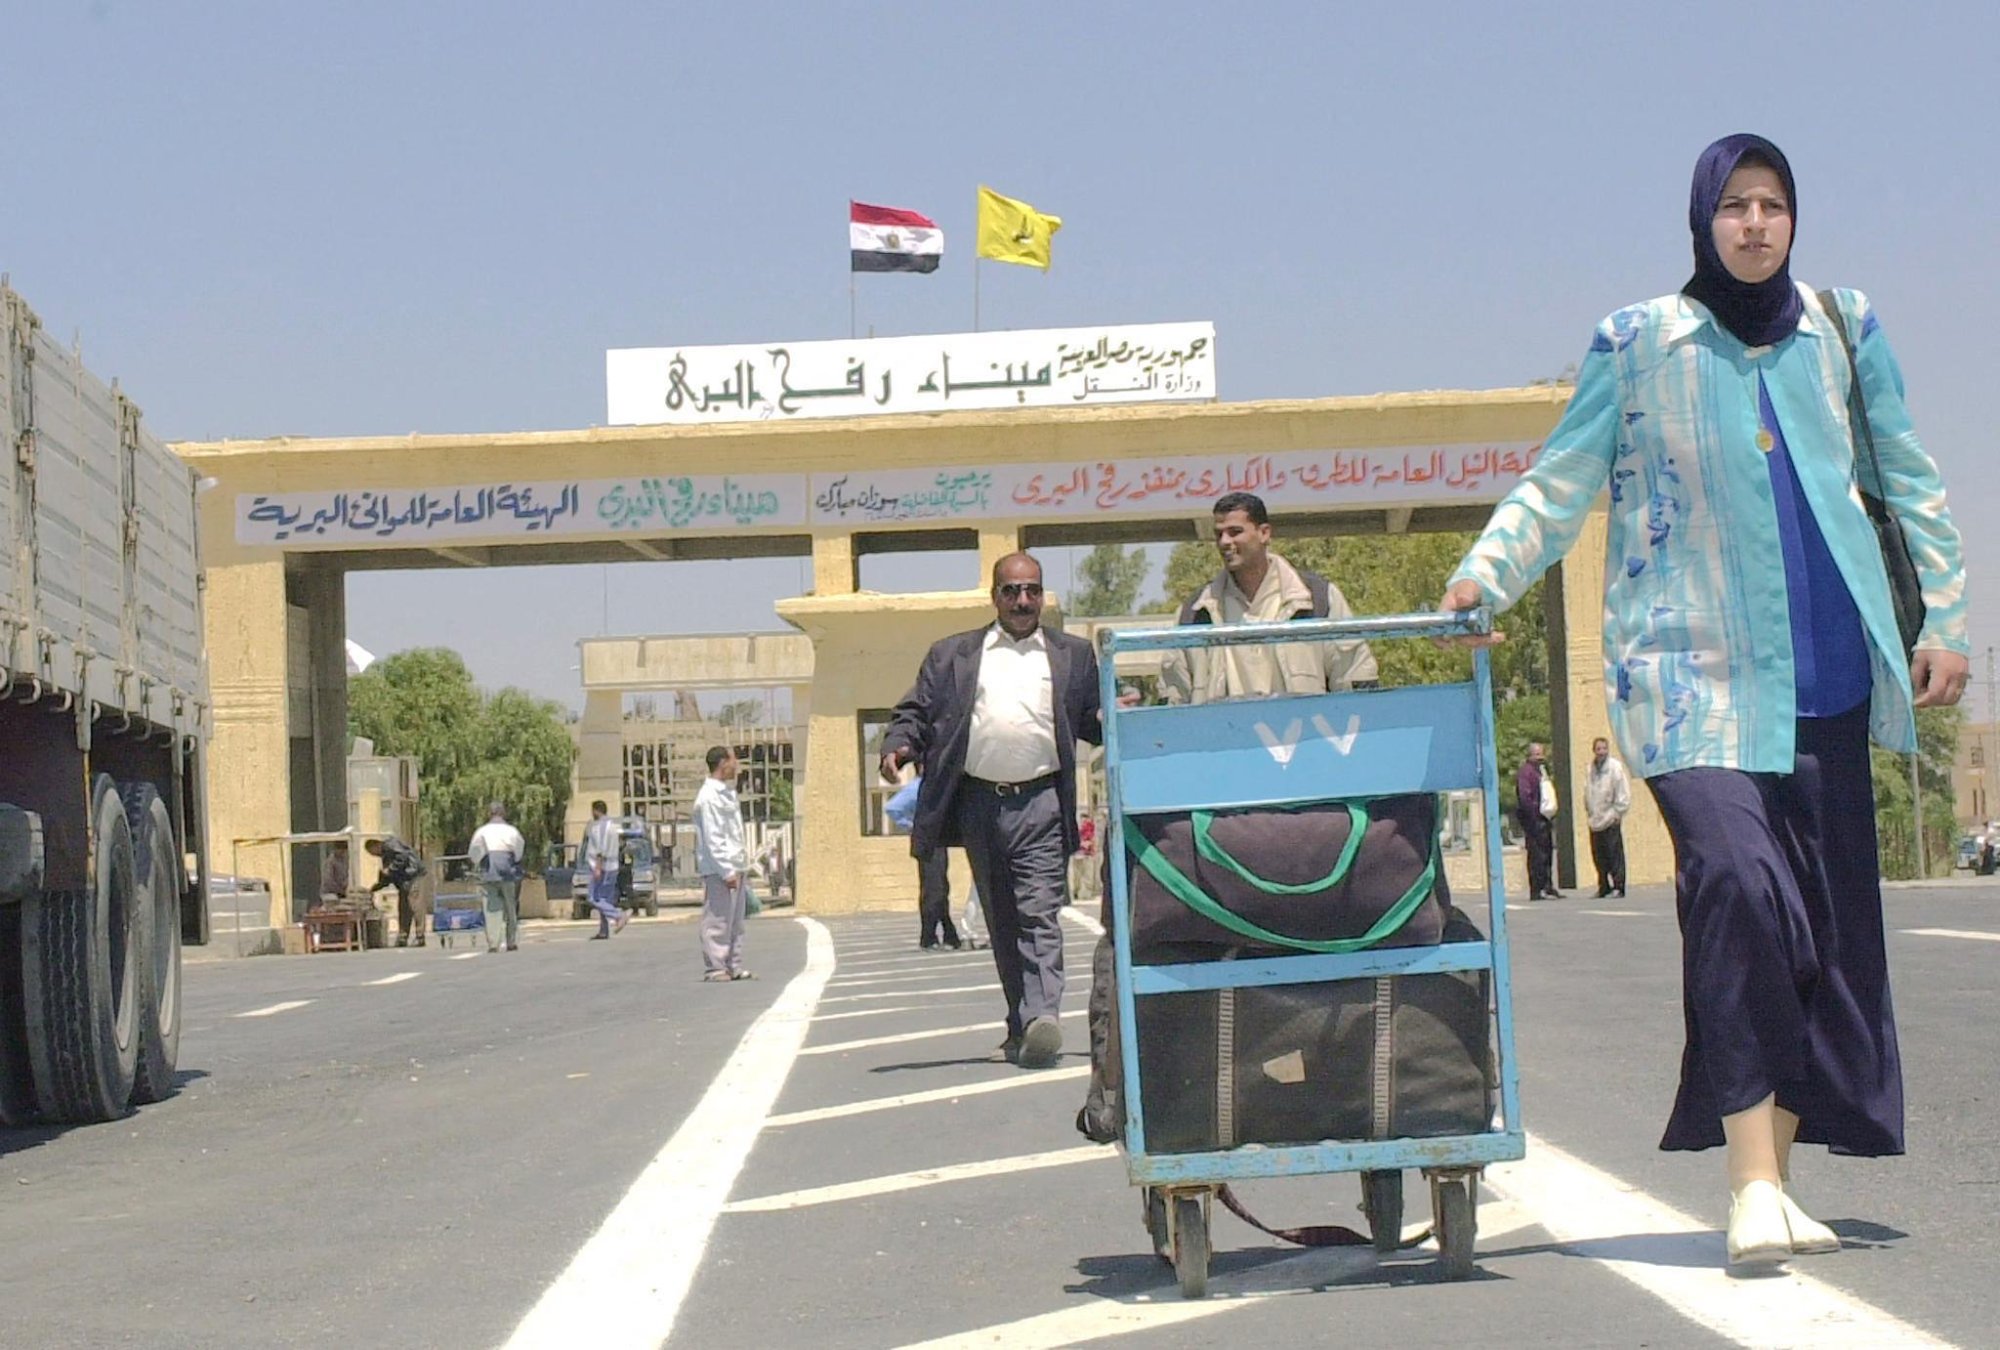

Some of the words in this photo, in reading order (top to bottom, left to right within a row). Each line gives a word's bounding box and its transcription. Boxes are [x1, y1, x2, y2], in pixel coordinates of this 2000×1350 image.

[917, 350, 1052, 403] ميناء
[1135, 337, 1208, 373] جمهورية
[766, 348, 891, 414] رفح
[1372, 449, 1445, 488] العامة
[1446, 449, 1498, 490] النيل
[247, 493, 350, 541] البرية
[427, 487, 496, 530] العامة
[496, 484, 579, 531] الهيئة
